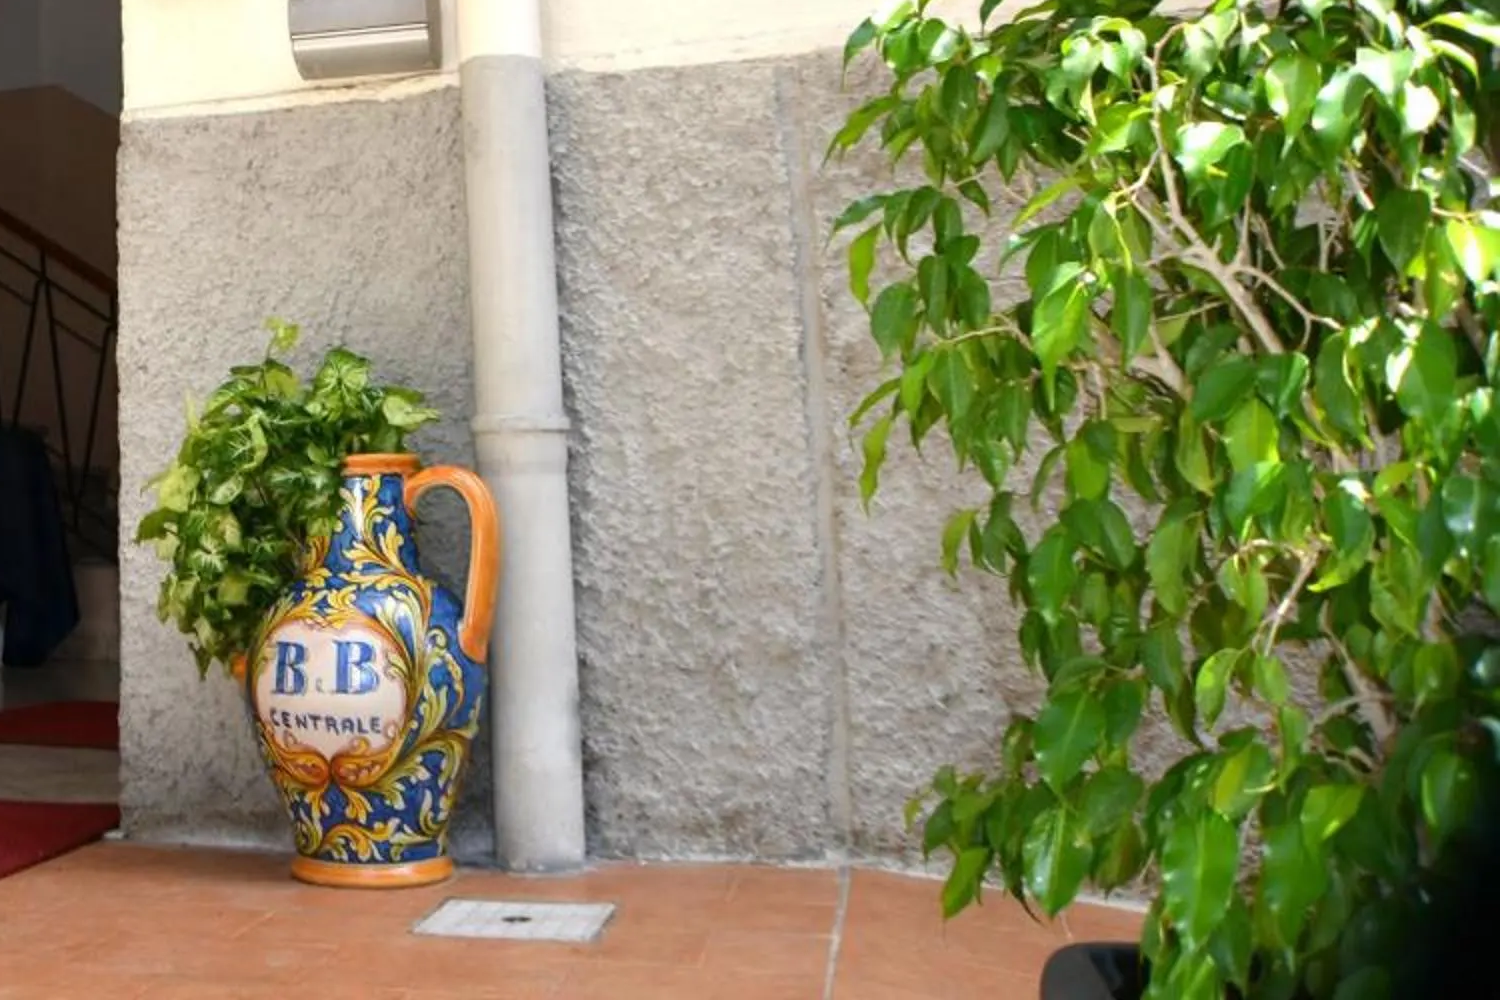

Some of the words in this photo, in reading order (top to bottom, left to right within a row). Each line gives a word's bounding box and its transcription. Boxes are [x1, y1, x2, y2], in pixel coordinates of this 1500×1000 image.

[271, 641, 307, 695] B
[331, 640, 380, 694] B
[269, 707, 382, 735] CENTRALE
